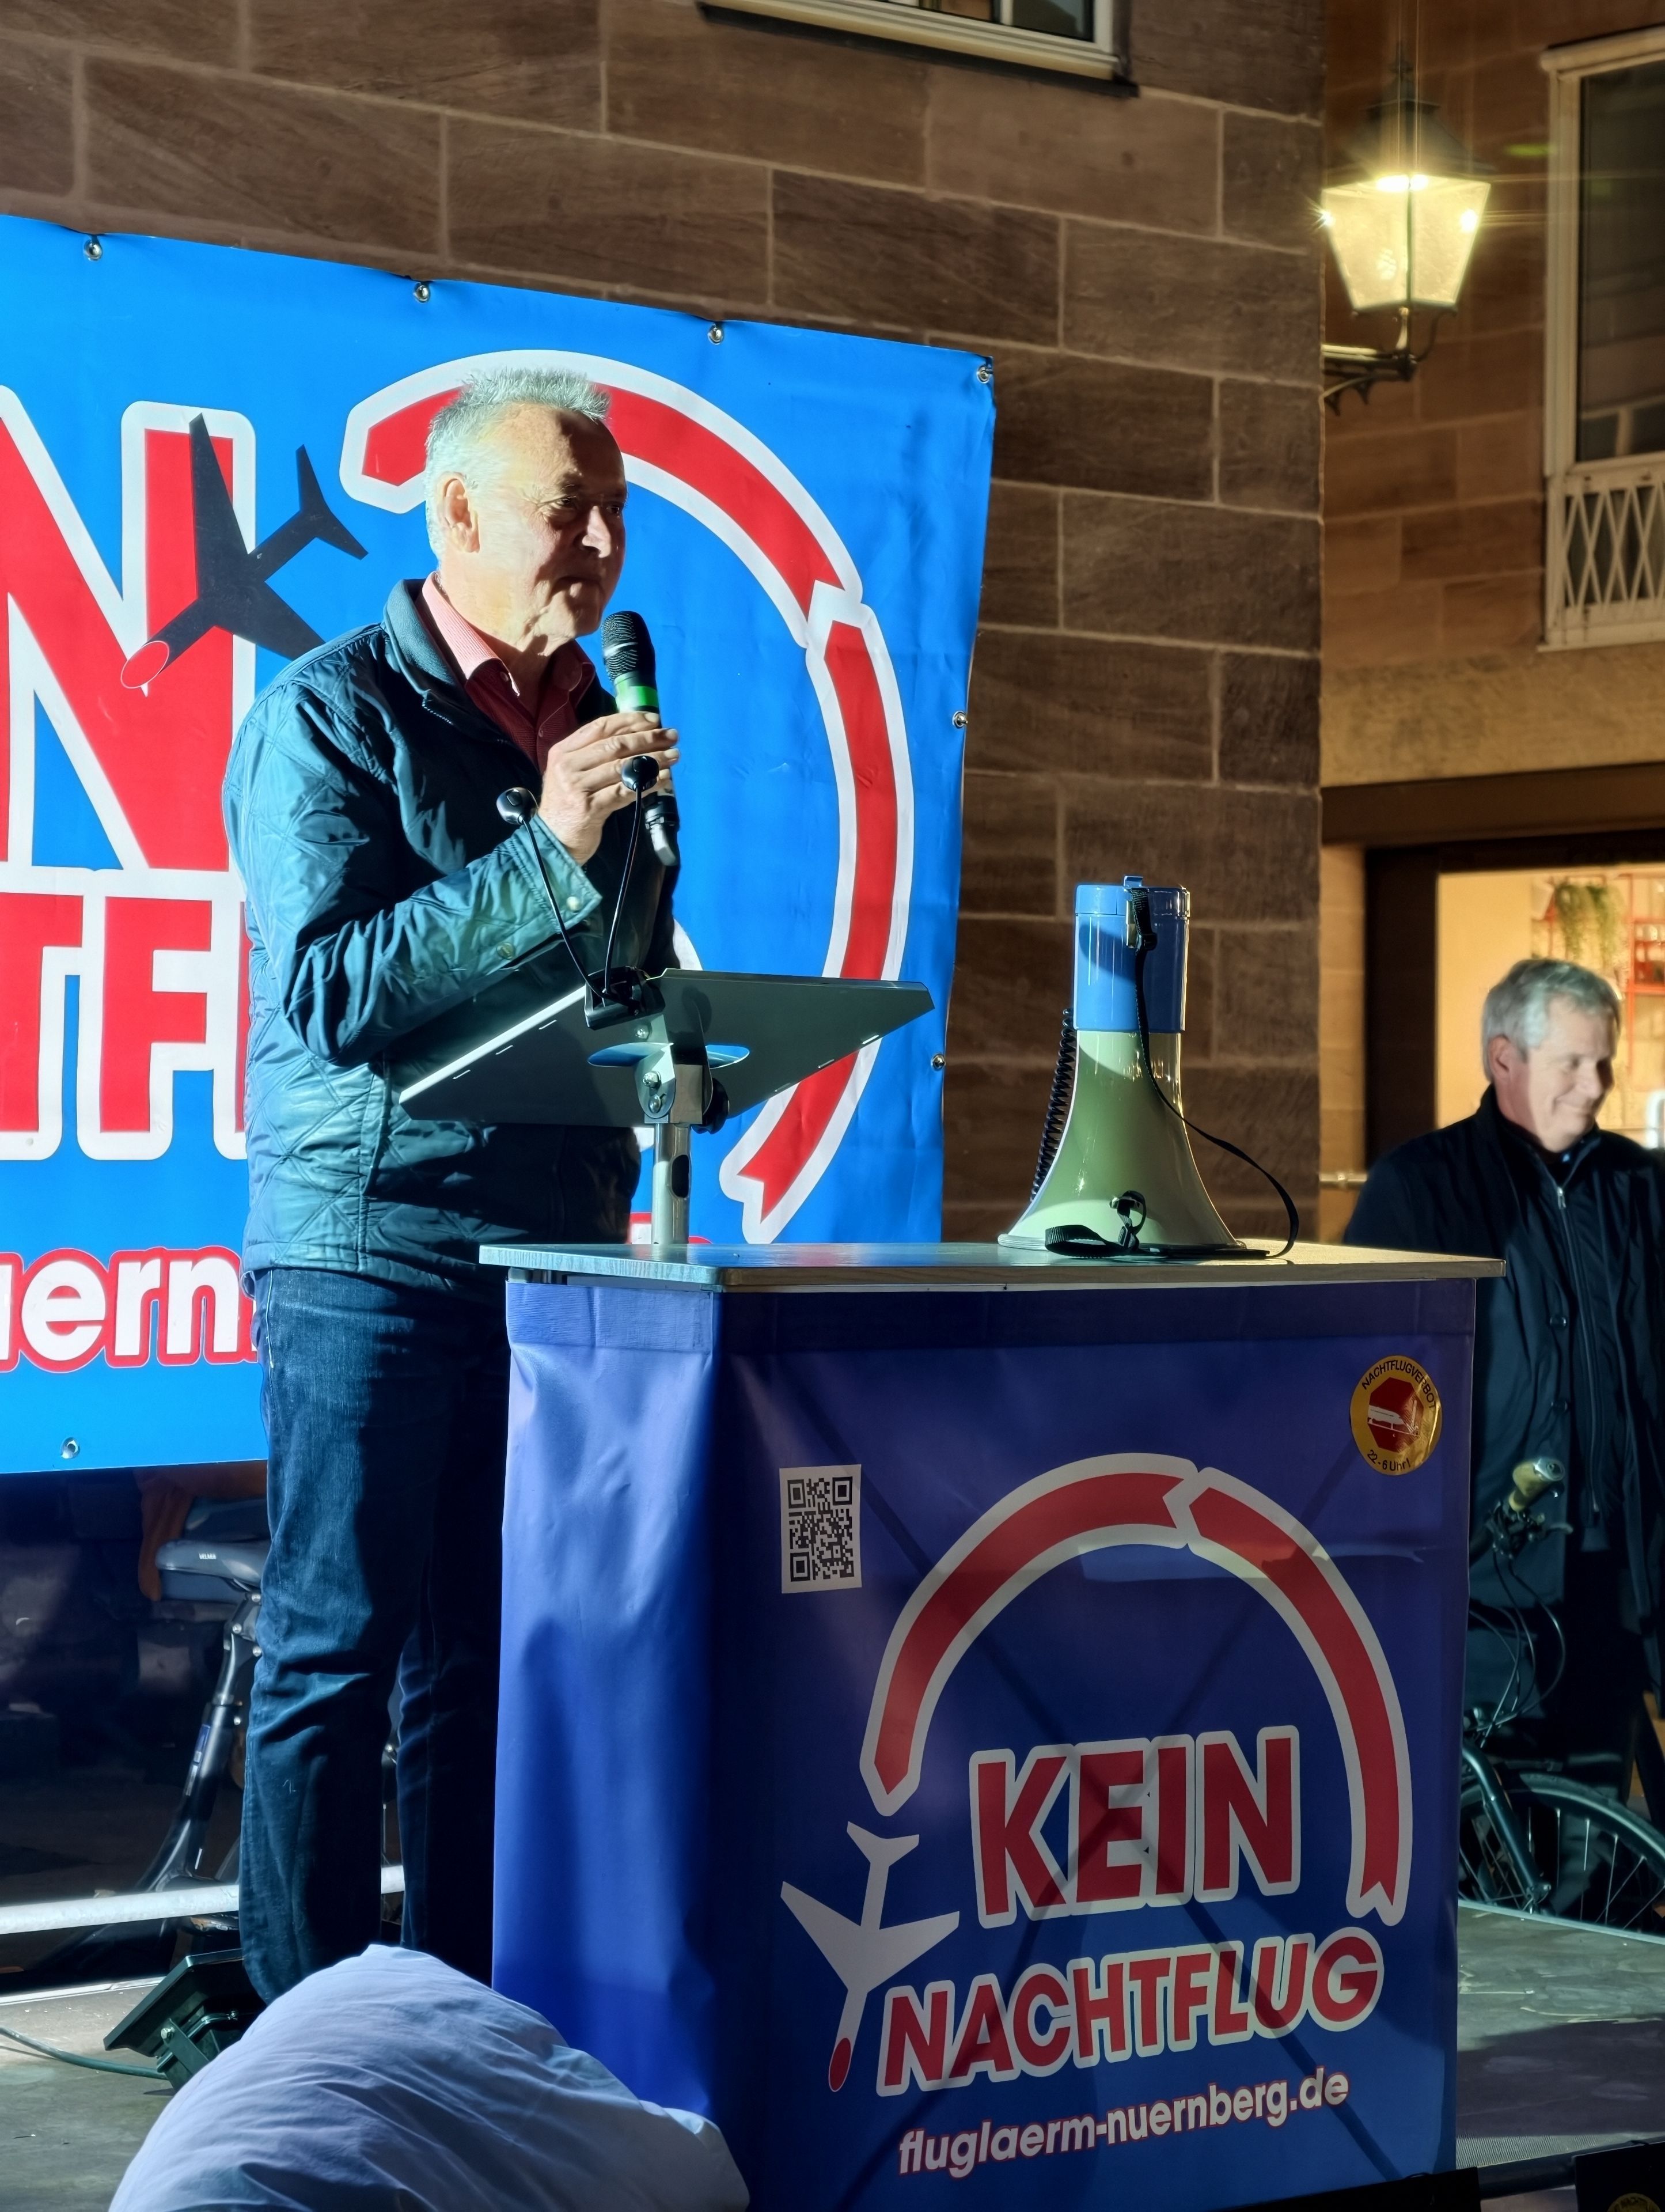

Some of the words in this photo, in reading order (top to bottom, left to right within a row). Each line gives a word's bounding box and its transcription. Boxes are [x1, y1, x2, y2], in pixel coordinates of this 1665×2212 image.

[1361, 1360, 1436, 1409] NACHTFLUGVERBOT
[976, 1735, 1295, 1917] KEIN
[882, 1934, 1380, 2088] NACHTFLUG
[898, 2066, 1350, 2179] fluglaerm-nuernberg.de
